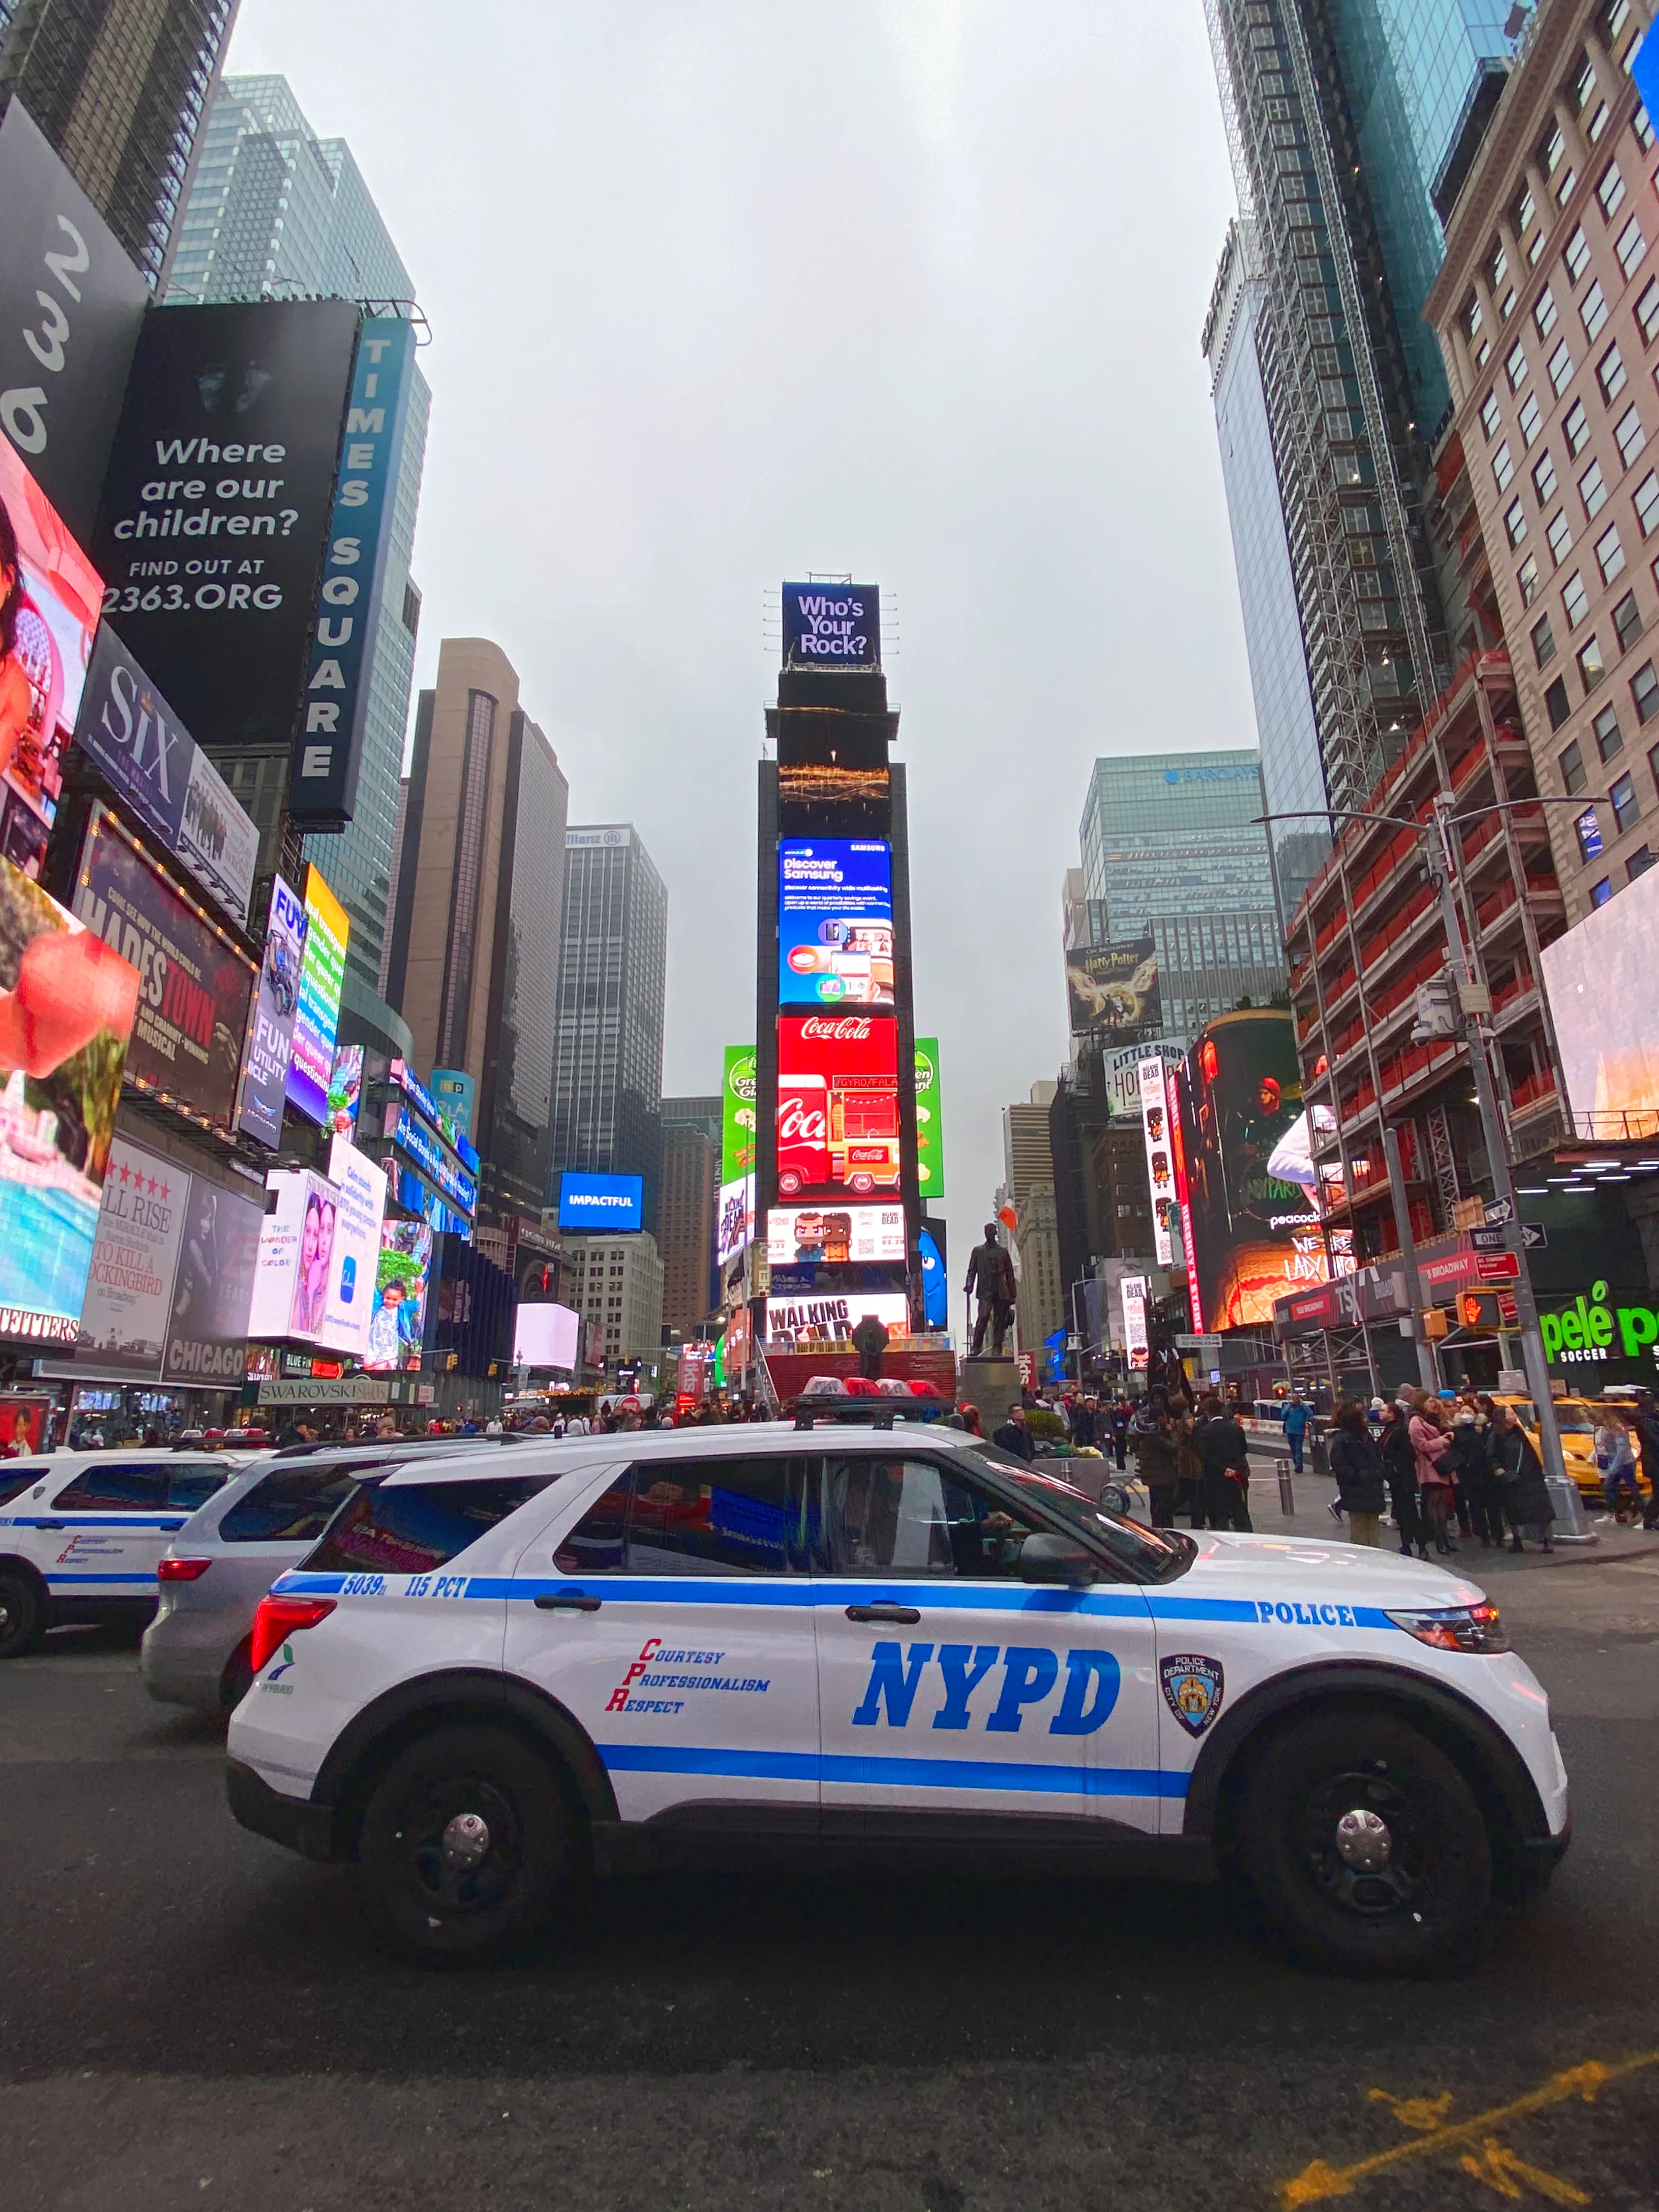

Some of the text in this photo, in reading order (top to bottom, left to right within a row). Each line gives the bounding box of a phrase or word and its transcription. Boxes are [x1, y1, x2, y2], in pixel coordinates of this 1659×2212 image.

[340, 338, 391, 507] TIMES
[155, 437, 286, 466] Where
[141, 478, 284, 501] are our
[115, 509, 300, 540] children?
[129, 559, 265, 577] FIND OUT AT
[798, 595, 864, 617] Who’s
[807, 615, 856, 636] Your
[801, 633, 868, 654] Rock?
[301, 536, 361, 778] SQUARE
[101, 666, 179, 805] SIX
[1183, 766, 1259, 782] BARCLAYS
[783, 858, 838, 870] Discover
[783, 868, 844, 883] Samsung
[307, 925, 331, 960] gender
[1098, 942, 1135, 953] BROADWAY
[316, 958, 335, 987] queer
[1085, 956, 1111, 974] Harry
[1109, 952, 1140, 970] Potter
[295, 1007, 321, 1042] gender
[800, 1016, 874, 1040] Coca-Cola
[256, 1014, 290, 1064] FUN
[305, 1038, 325, 1066] queer
[1113, 1044, 1152, 1072] LITTLE
[1154, 1044, 1185, 1060] SHOP
[253, 1045, 286, 1082] UTILITY
[1142, 1068, 1160, 1081] DEAD
[840, 1078, 867, 1087] GYRO
[852, 1148, 885, 1161] Coca-Cola
[101, 1184, 172, 1234] LL RISE
[569, 1194, 634, 1207] IMPACTFUL
[272, 1225, 289, 1234] THE
[881, 1216, 899, 1225] DEAD
[1270, 1210, 1321, 1231] peacock
[1291, 1236, 1320, 1254] WE
[1481, 1233, 1503, 1244] ONE
[95, 1239, 154, 1275] TO KILL A
[1432, 1257, 1469, 1278] BROADWAY
[785, 1298, 795, 1307] THE
[1127, 1288, 1144, 1299] DEAD
[768, 1298, 849, 1331] WALKING
[1538, 1280, 1615, 1364] pelé
[169, 1338, 244, 1377] CHICAGO
[286, 1353, 301, 1367] BLUE
[1560, 1348, 1607, 1363] SOCCER
[260, 1384, 356, 1399] SWAROVSKI
[343, 1574, 384, 1595] 5039
[404, 1576, 468, 1598] 115 PCT
[1256, 1601, 1355, 1627] POLICE
[638, 1638, 727, 1666] COURTESY
[1175, 1656, 1206, 1667] POLICE
[621, 1662, 772, 1693] PROFESSIONALISM
[1163, 1664, 1220, 1682] DEPARTMENT
[851, 1640, 1121, 1736] NYPD
[604, 1687, 685, 1715] RESPECT
[1164, 1686, 1186, 1721] CITY OF
[1202, 1686, 1223, 1726] NEW YORK
